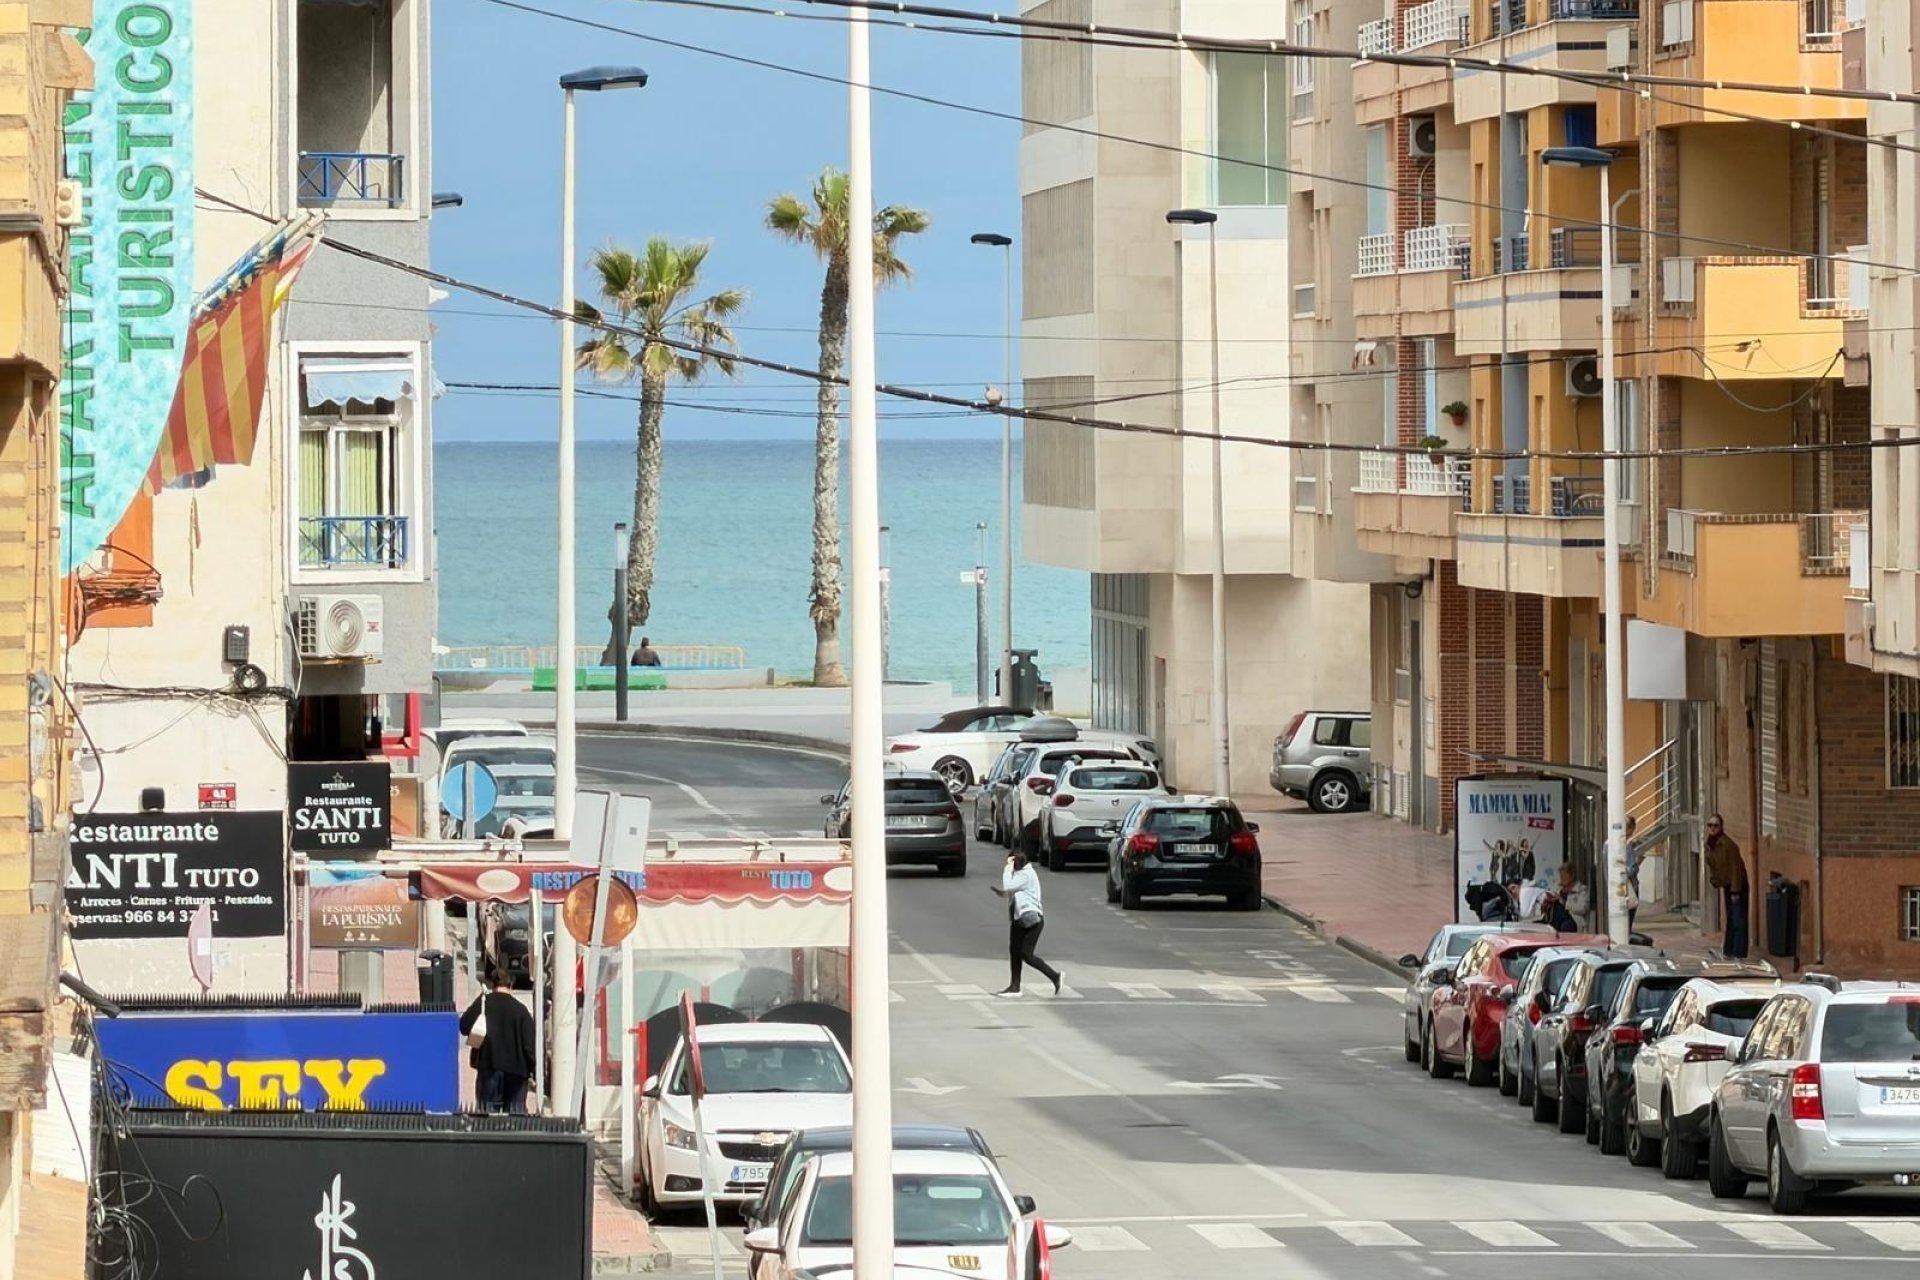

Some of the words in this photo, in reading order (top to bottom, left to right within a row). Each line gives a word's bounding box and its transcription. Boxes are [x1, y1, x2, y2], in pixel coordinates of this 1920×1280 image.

[114, 3, 174, 363] TURISTICO
[305, 796, 373, 806] Restaurante
[1469, 793, 1519, 814] MAMMA
[1522, 793, 1552, 814] MIA!
[295, 807, 382, 830] SANTI
[318, 831, 361, 844] TUTO
[184, 867, 260, 888] TUTO
[532, 871, 646, 891] RESTNTE
[770, 869, 813, 889] TUTO
[80, 897, 122, 907] Arroces
[131, 896, 167, 906] Carnes
[174, 895, 216, 906] Frituras
[224, 894, 273, 905] Pescados
[73, 911, 123, 924] eservas:
[124, 909, 153, 924] 966
[157, 909, 175, 923] 84
[322, 914, 339, 926] LA
[341, 911, 402, 926] PURÍSIMA
[1890, 1089, 1919, 1101] 3476
